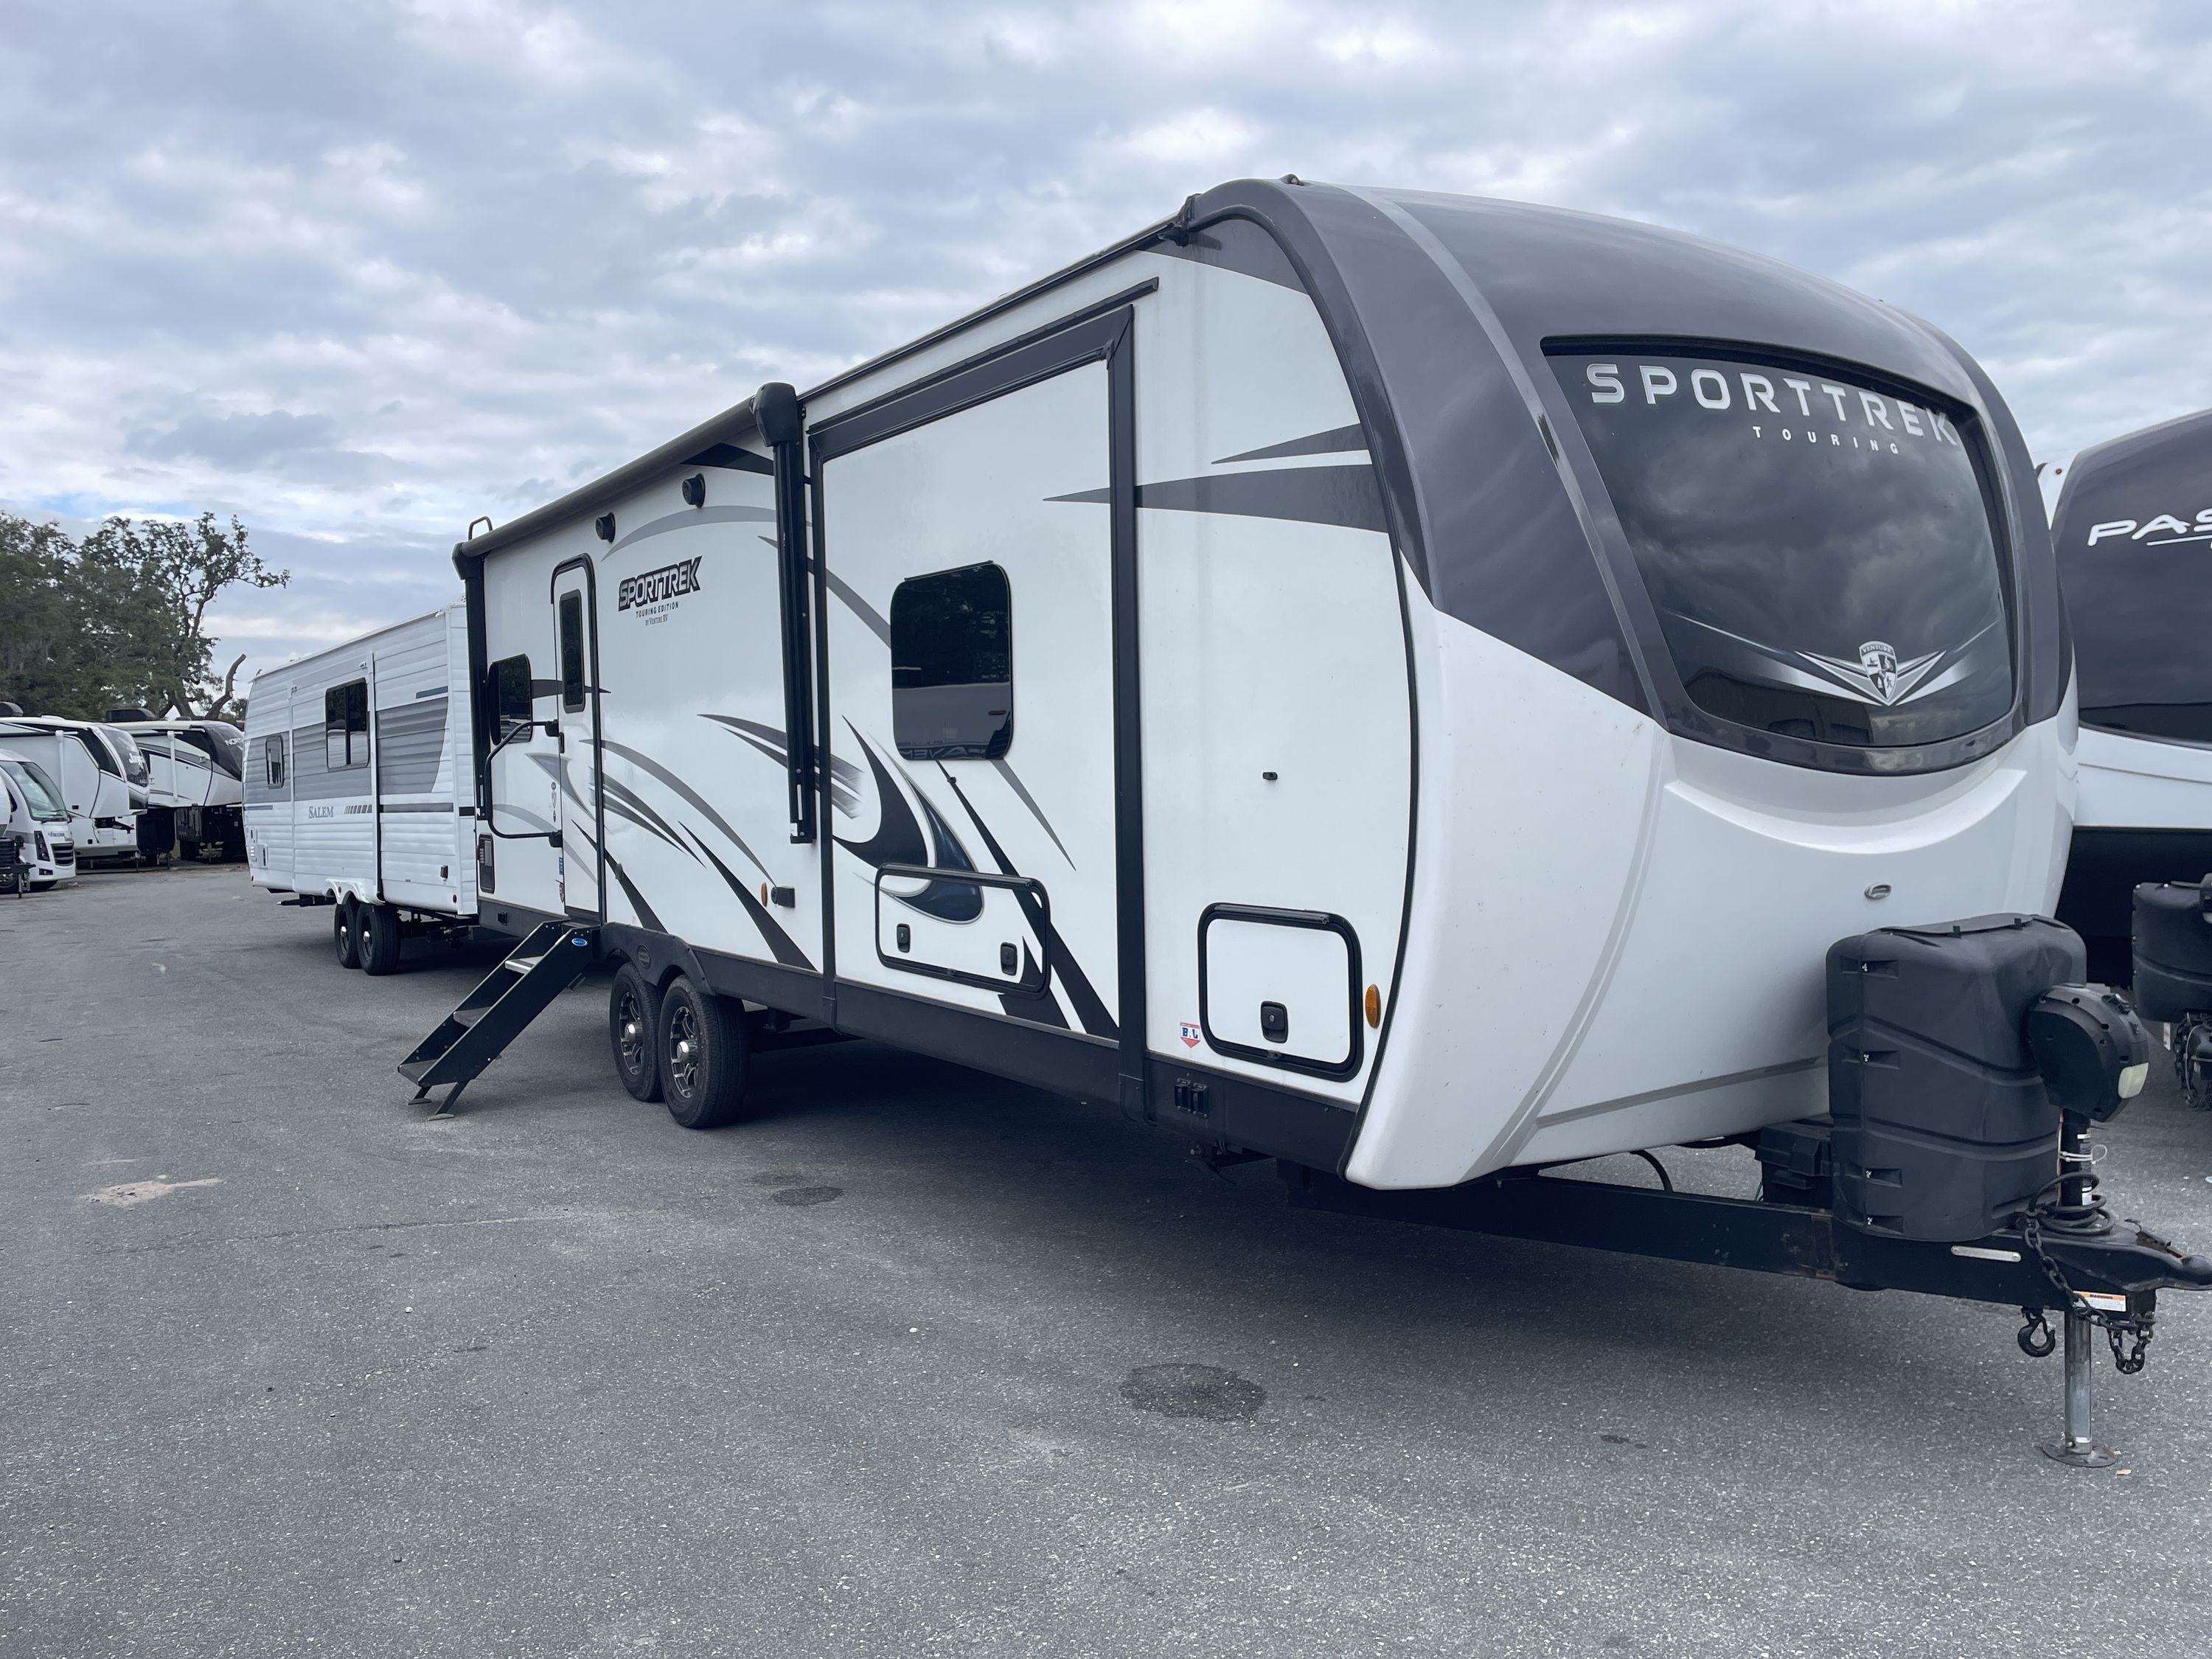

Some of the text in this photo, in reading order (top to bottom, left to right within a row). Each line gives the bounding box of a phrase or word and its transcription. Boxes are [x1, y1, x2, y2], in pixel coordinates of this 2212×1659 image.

[1587, 363, 1958, 445] SPORTTREK
[1752, 425, 1899, 454] TOURING
[619, 556, 703, 611] SPORTTREK
[636, 601, 679, 619] TOURING EDITION
[308, 806, 334, 818] SALEM
